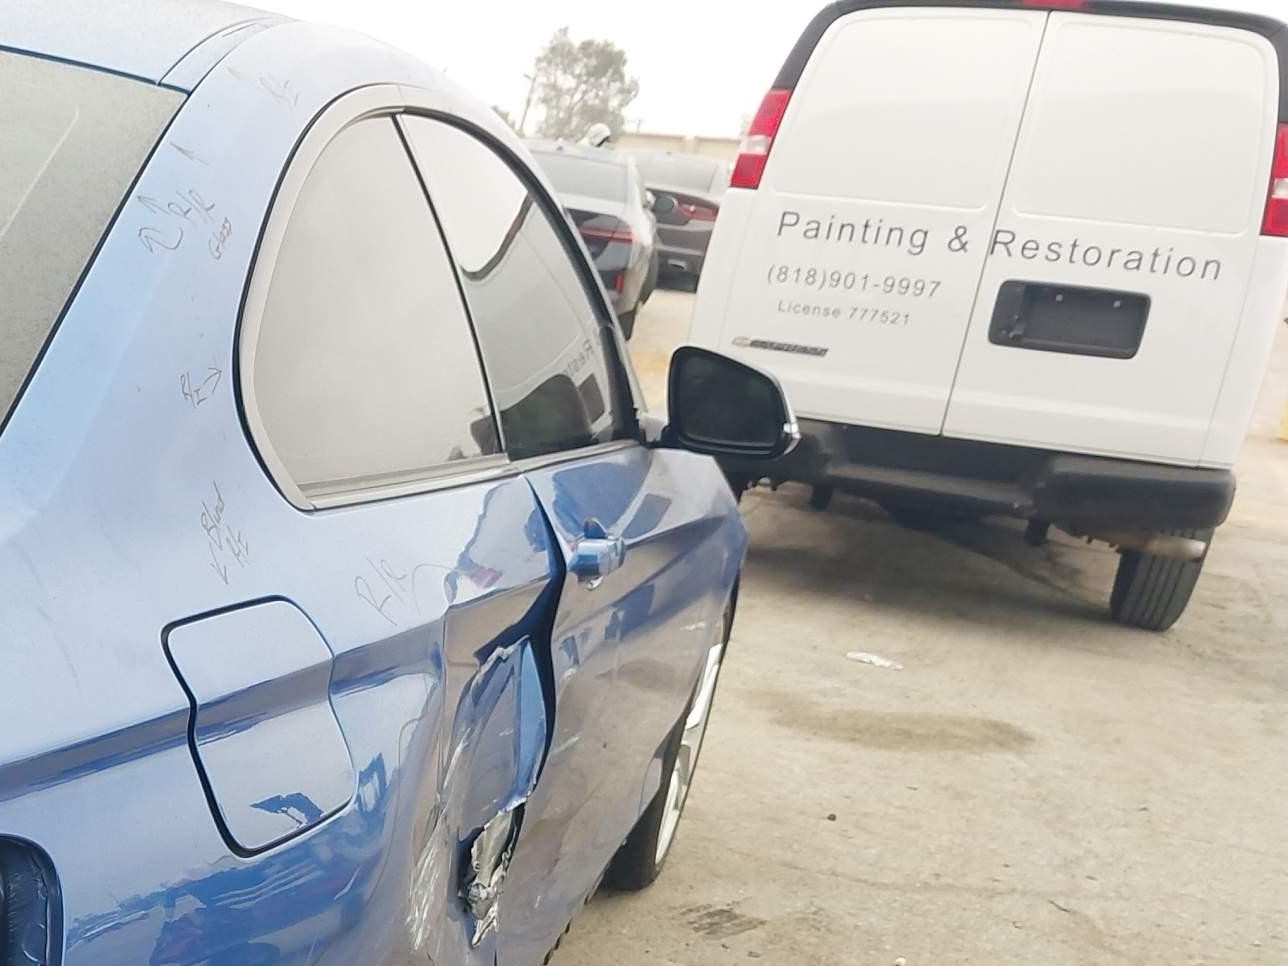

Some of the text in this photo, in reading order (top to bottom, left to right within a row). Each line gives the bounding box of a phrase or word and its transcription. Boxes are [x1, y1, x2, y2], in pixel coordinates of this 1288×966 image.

[777, 210, 1223, 281] Painting & Restoration
[767, 264, 942, 299] (818)901-9997
[777, 299, 911, 327] License 777521
